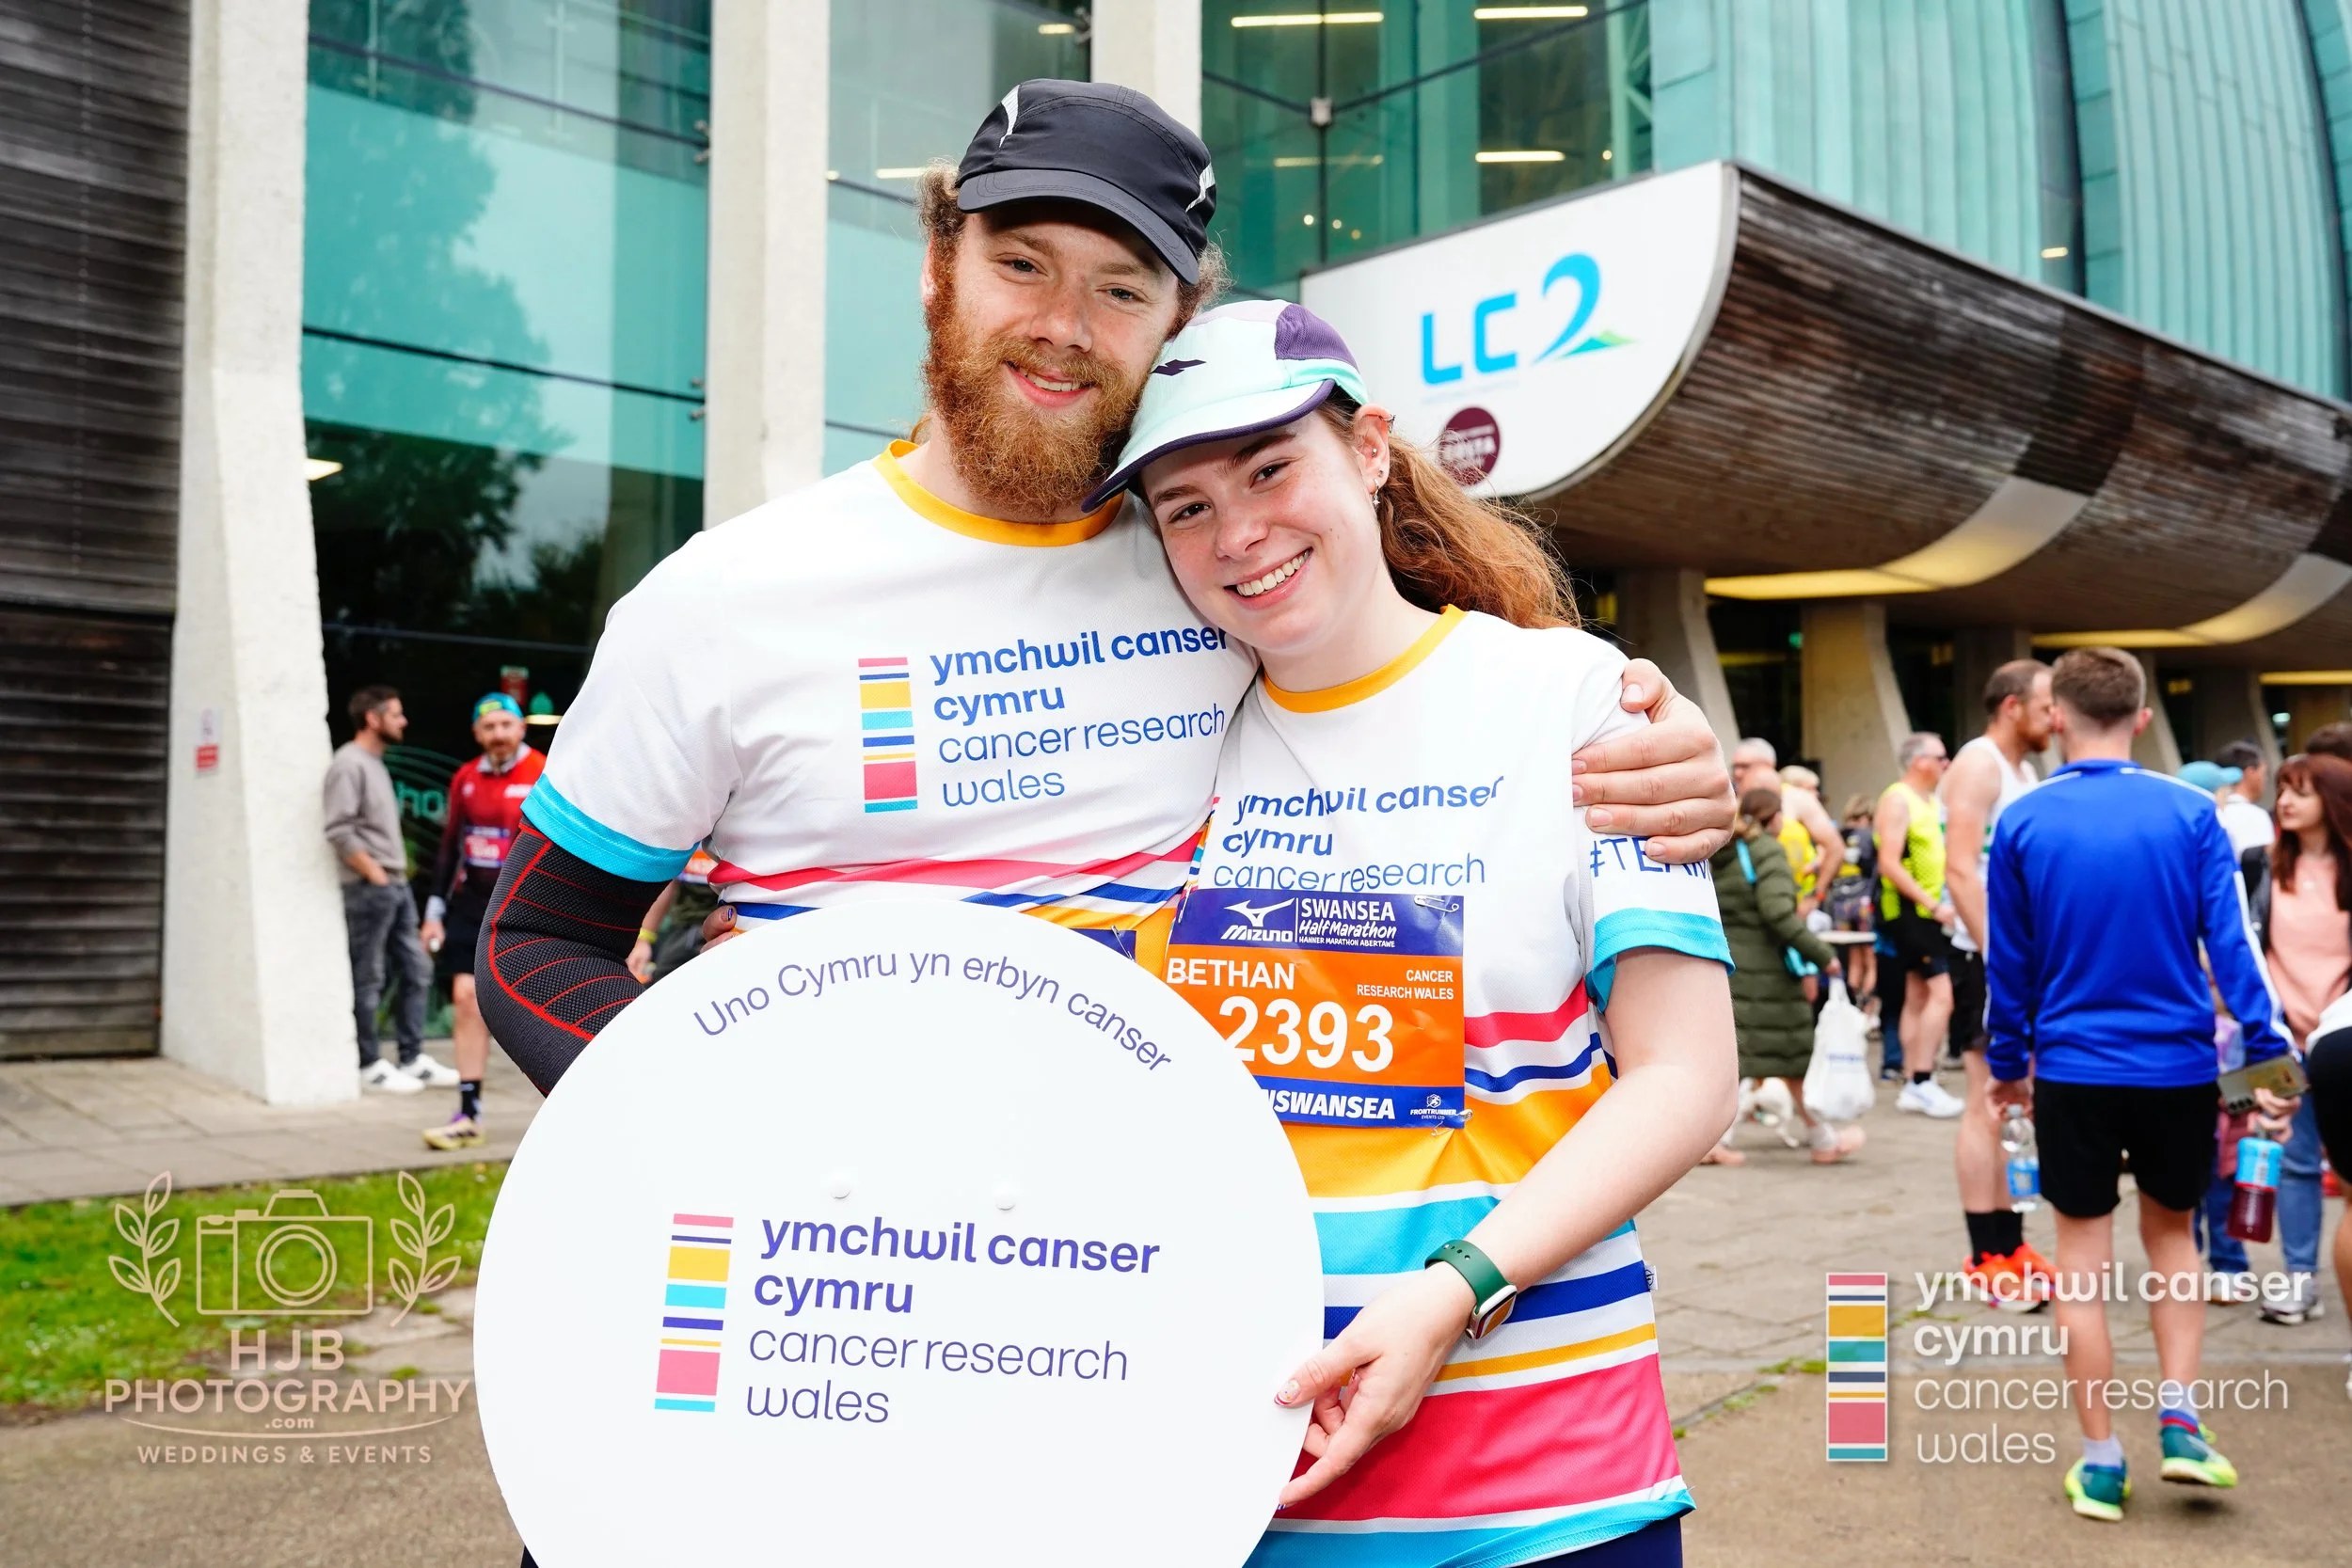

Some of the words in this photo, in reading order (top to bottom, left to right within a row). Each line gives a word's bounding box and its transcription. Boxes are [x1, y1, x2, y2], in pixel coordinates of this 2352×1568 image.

[930, 630, 1105, 686] ymchwil
[933, 687, 1066, 726] cymru
[939, 725, 1077, 763] cancer
[1084, 703, 1225, 750] research
[943, 768, 1065, 807] wales
[1375, 776, 1504, 814] canser
[1222, 828, 1333, 858] cymru
[1214, 864, 1336, 892] cancer
[1340, 852, 1486, 893] research
[1301, 897, 1396, 921] SWANSEA
[1298, 936, 1325, 944] HANNER
[1326, 937, 1359, 946] MARATHON
[1359, 940, 1395, 948] ABERTAWE
[1167, 957, 1295, 990] BETHAN
[1357, 984, 1412, 1000] RESEARCH
[1413, 987, 1454, 1000] WALES
[1406, 969, 1454, 983] CANCER
[693, 986, 771, 1037] Uno
[777, 953, 898, 997] Cymru
[909, 952, 951, 983] yn
[963, 956, 1060, 1003] erbyn
[1066, 991, 1172, 1072] canser
[1218, 994, 1394, 1073] 2393
[760, 1216, 977, 1263] ymchwil
[987, 1233, 1161, 1274] canser
[754, 1274, 914, 1317] cymru
[749, 1329, 918, 1369] cancer
[925, 1339, 1128, 1381] research
[746, 1380, 890, 1423] wales
